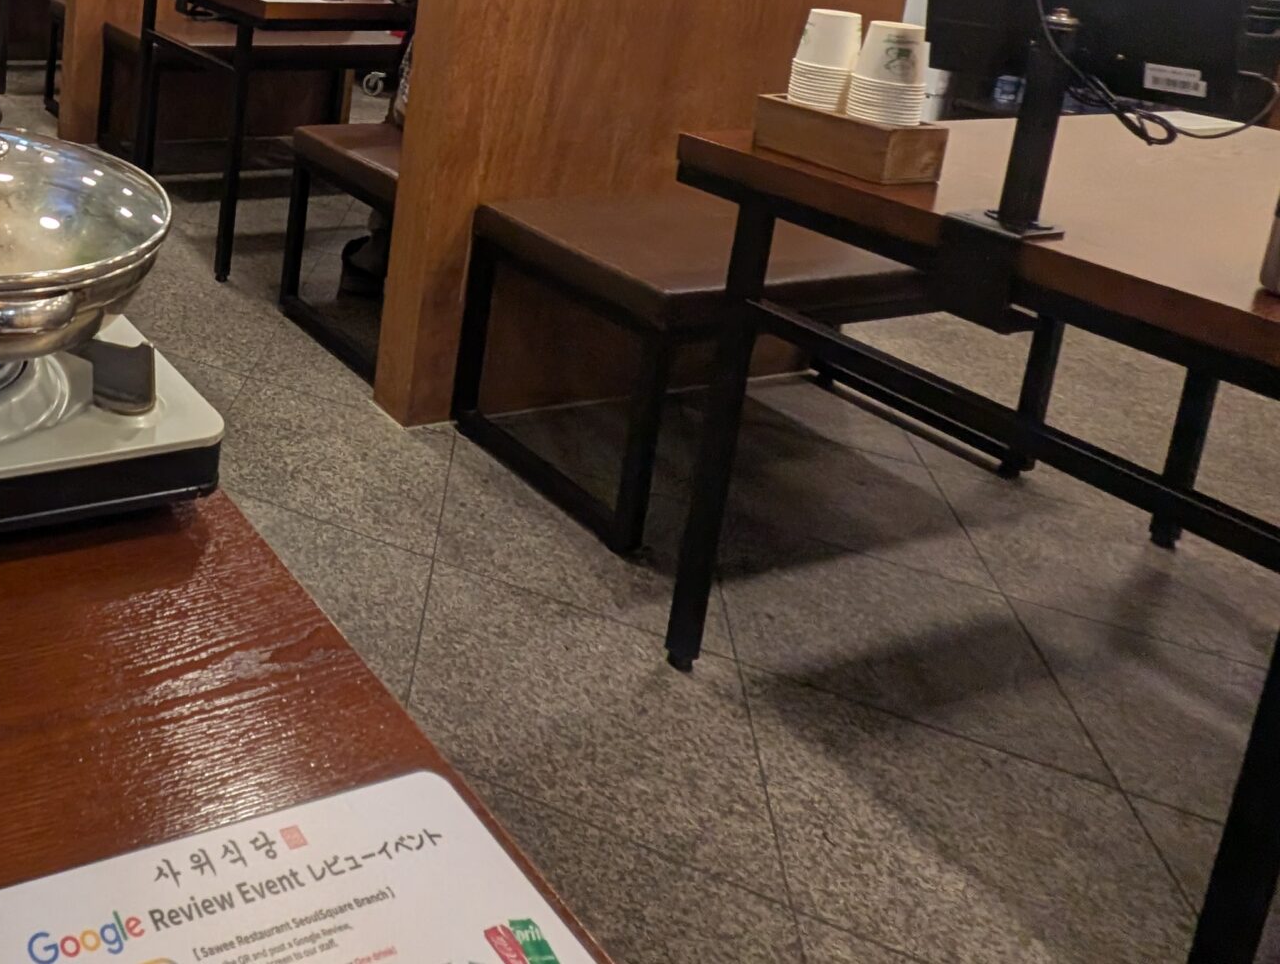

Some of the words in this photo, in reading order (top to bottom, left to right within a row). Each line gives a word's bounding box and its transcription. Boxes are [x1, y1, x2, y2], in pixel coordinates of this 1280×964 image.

[153, 830, 278, 888] 사위식당
[307, 828, 443, 882] レビューイベント
[27, 910, 145, 964] Google
[148, 890, 235, 933] Review
[236, 868, 306, 905] Event
[200, 940, 236, 959] Sawee
[235, 921, 294, 946] Restaurant
[353, 890, 390, 910] Branch
